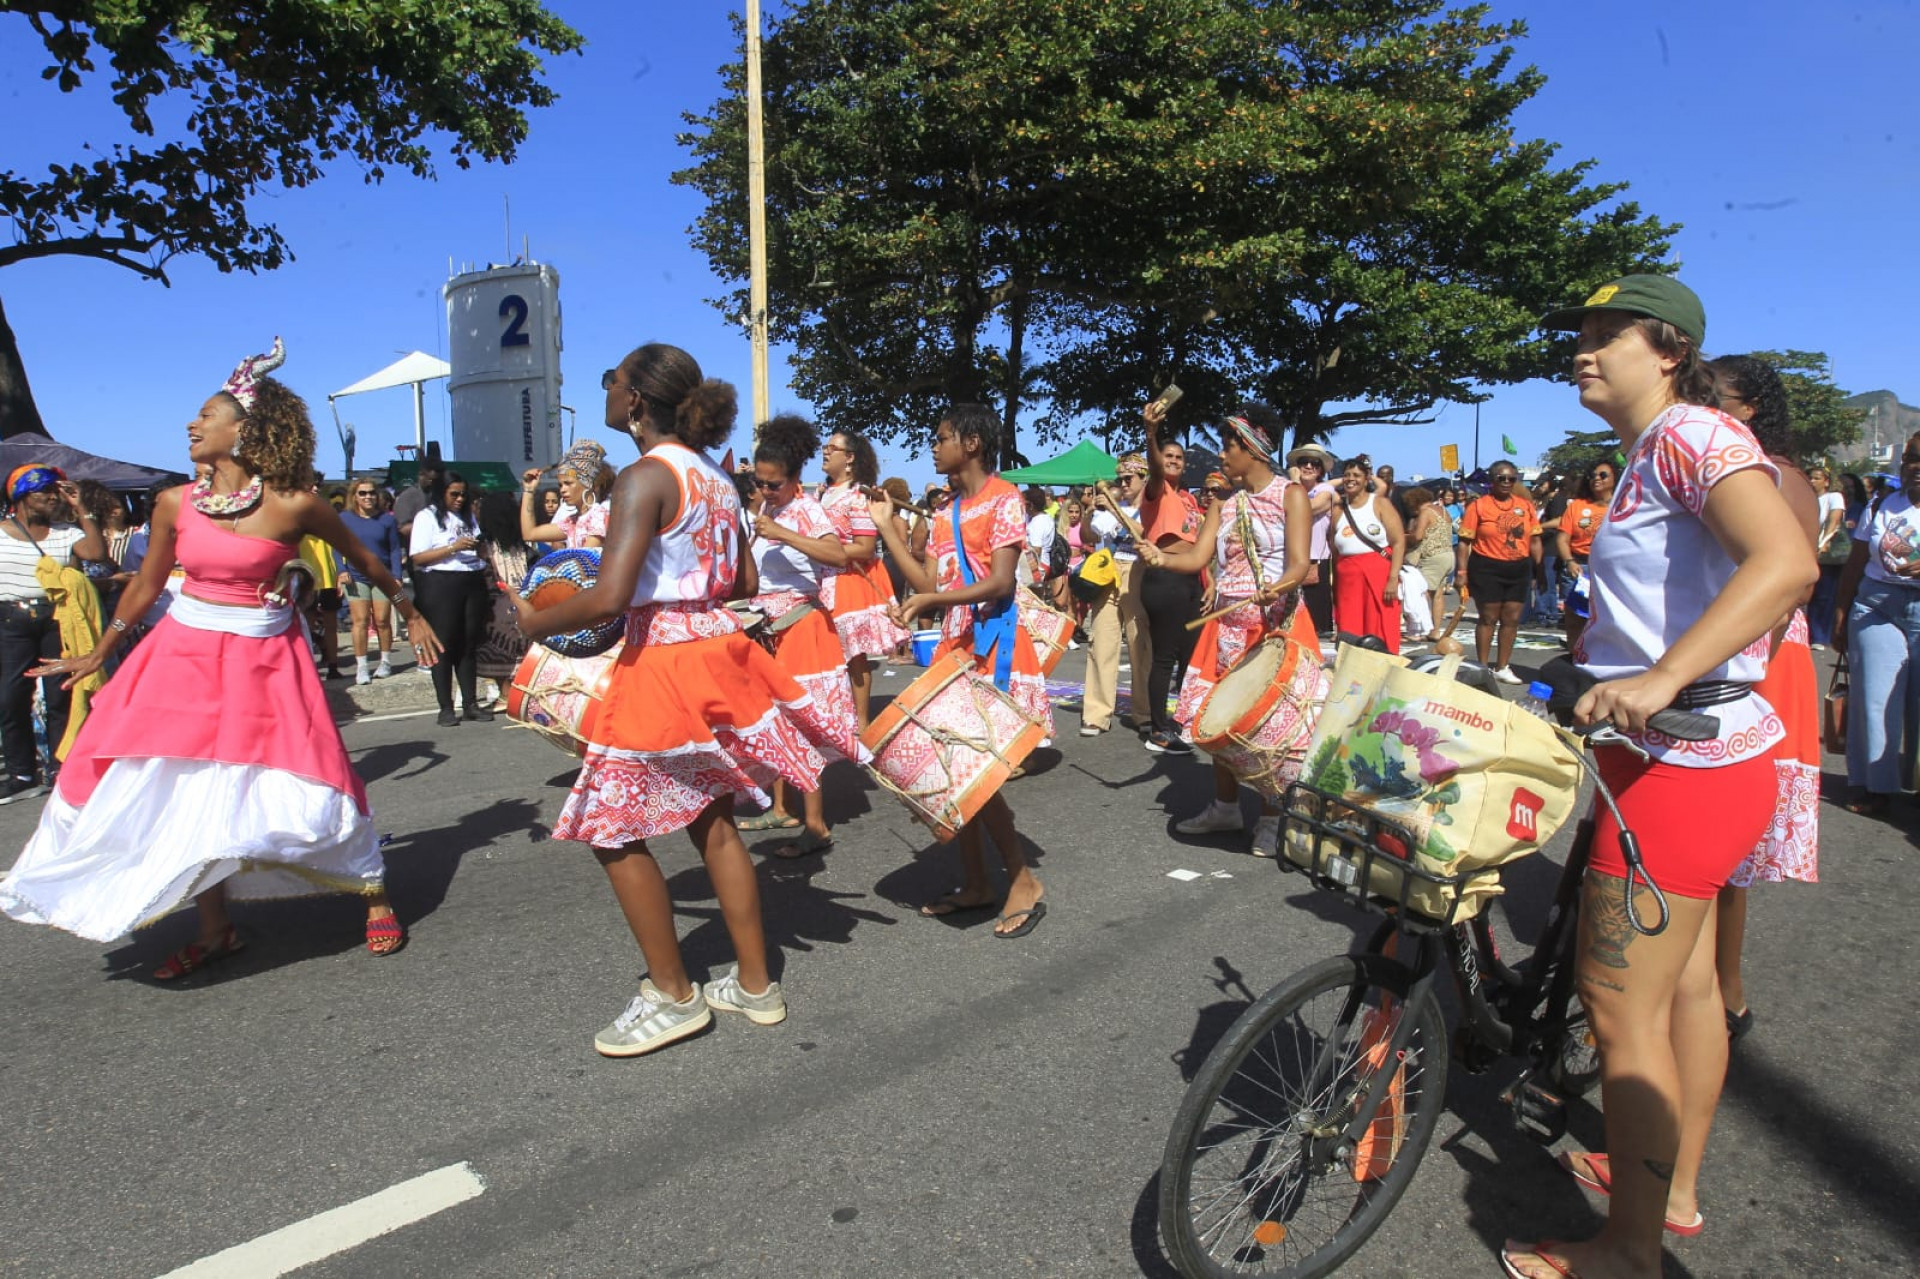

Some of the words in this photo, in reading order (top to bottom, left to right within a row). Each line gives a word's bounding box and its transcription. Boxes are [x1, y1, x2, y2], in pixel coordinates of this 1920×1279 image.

[499, 294, 529, 347] 2
[522, 387, 534, 462] PREFEITURA
[1423, 701, 1494, 732] mambo
